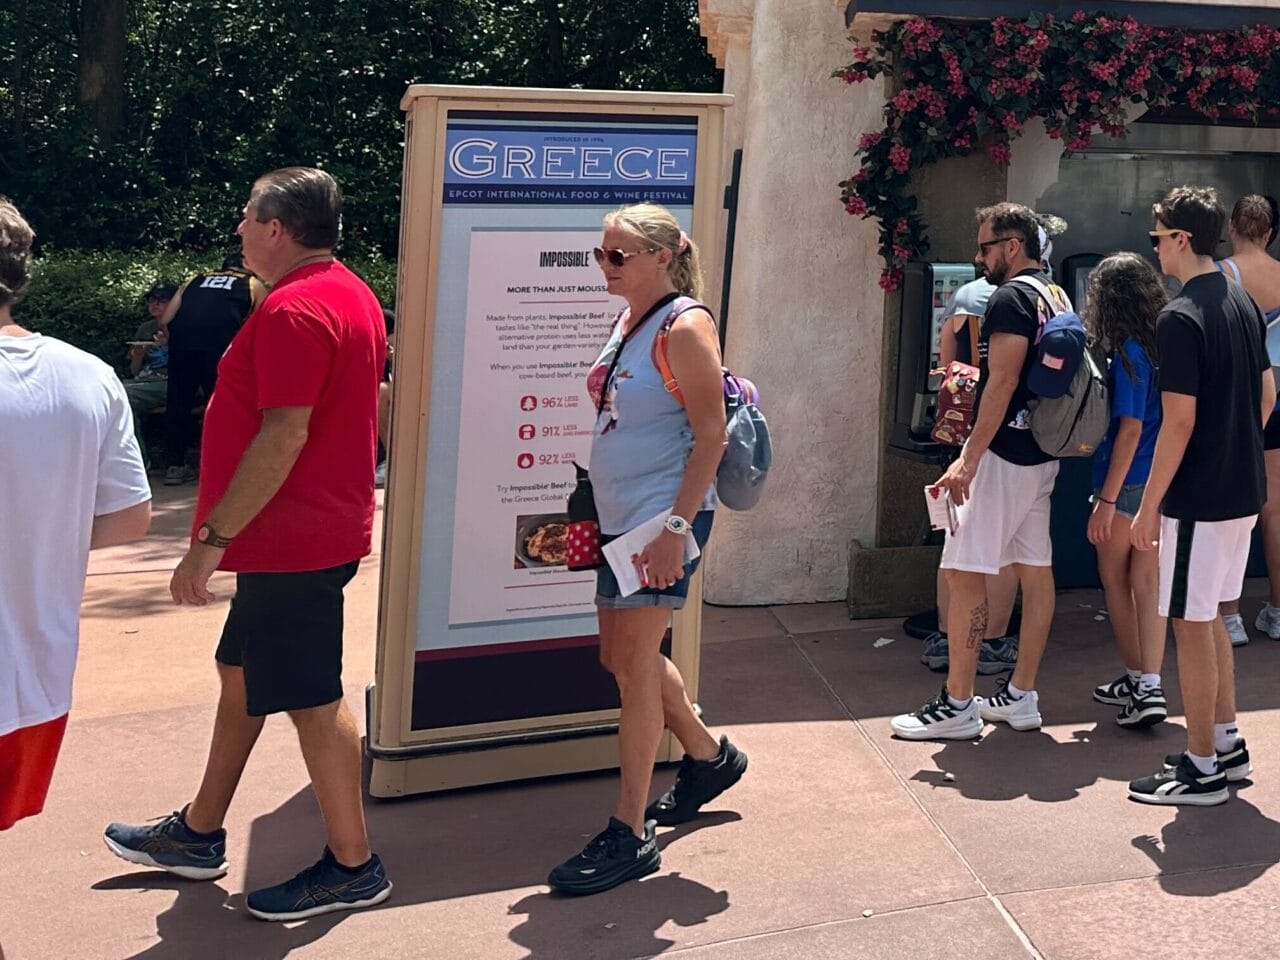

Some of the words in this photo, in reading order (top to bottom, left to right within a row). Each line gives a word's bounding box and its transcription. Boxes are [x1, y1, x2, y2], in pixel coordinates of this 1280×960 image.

[448, 138, 689, 181] GREECE
[449, 190, 483, 199] EPCOT
[487, 190, 568, 199] INTERNATIONAL
[571, 191, 600, 199] FOOD
[603, 191, 611, 199] &
[614, 191, 641, 200] WINE
[644, 191, 688, 200] FESTIVAL
[507, 286, 530, 294] MORE
[536, 334, 561, 342] protein
[541, 397, 563, 408] 96%
[542, 426, 560, 437] 91%
[539, 453, 559, 465] 92%
[496, 484, 509, 493] Try
[514, 495, 539, 503] Greece
